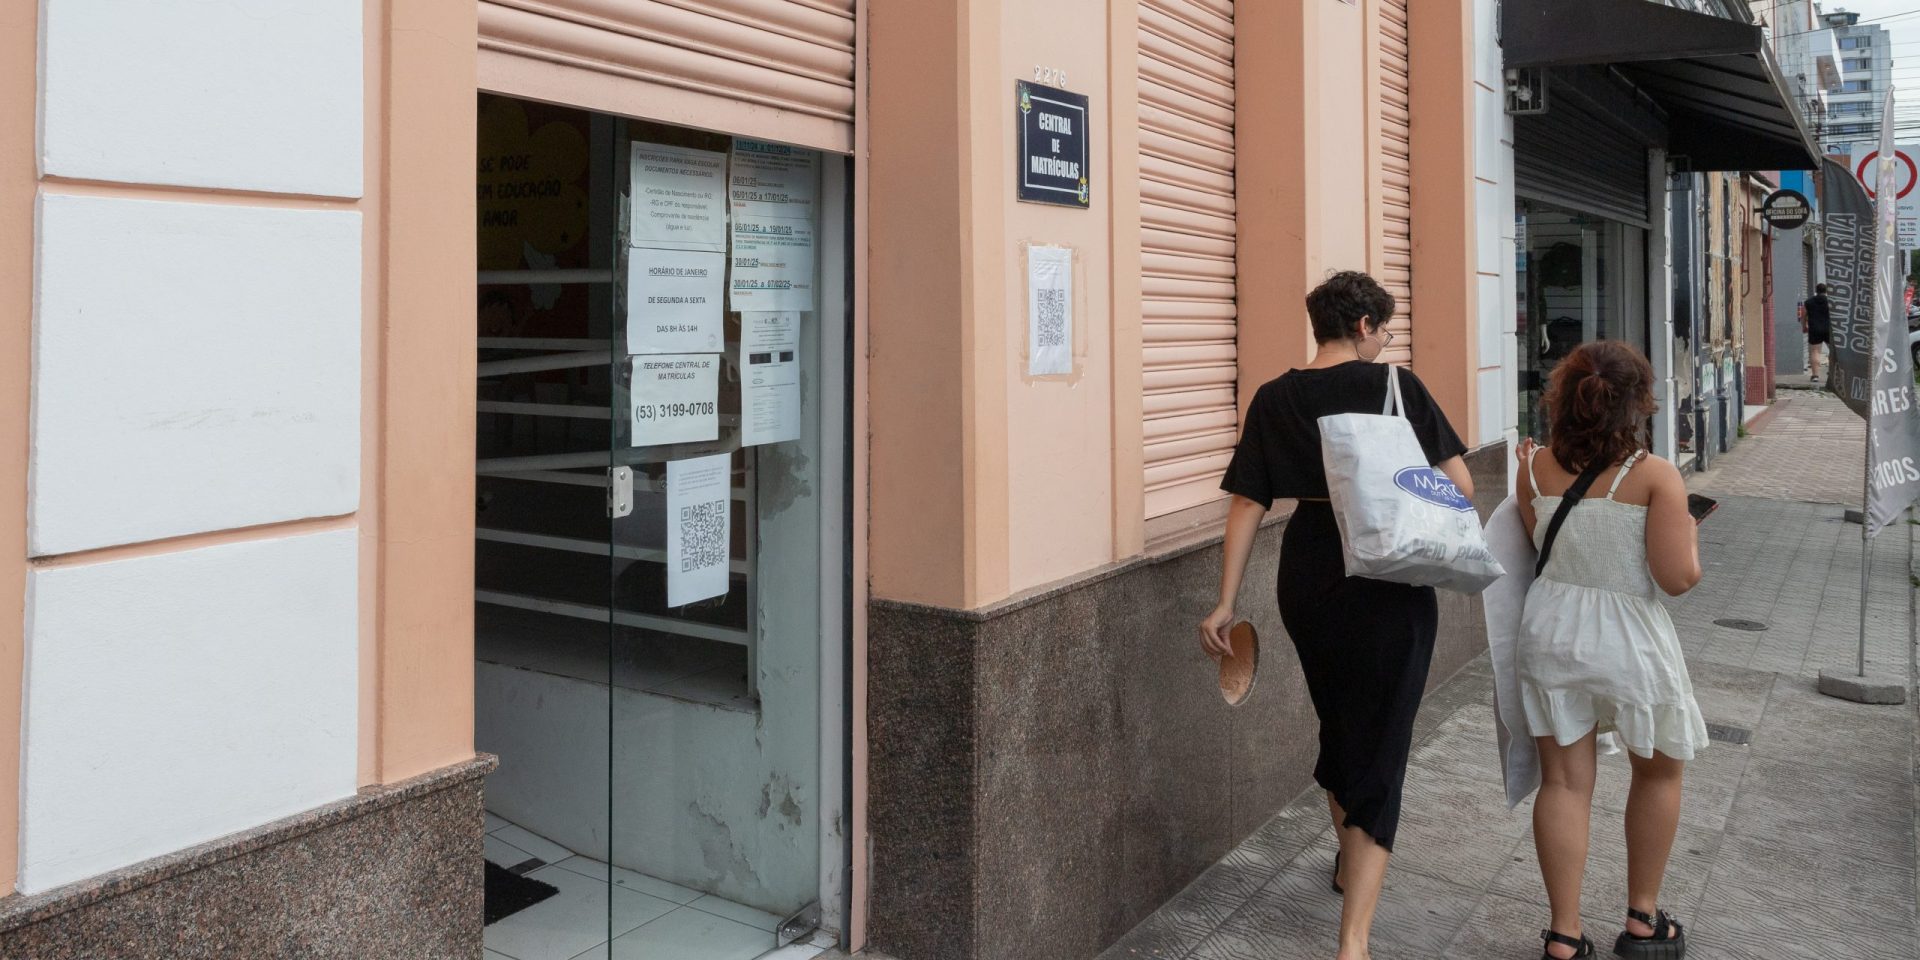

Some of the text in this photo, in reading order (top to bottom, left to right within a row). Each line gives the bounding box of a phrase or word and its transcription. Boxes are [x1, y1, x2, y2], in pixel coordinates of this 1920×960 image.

[1038, 112, 1072, 136] CENTRAL
[1051, 138, 1060, 153] DE
[500, 154, 531, 172] PODE
[1031, 155, 1079, 180] MATRÍCULAS
[764, 192, 789, 203] 17/01/25
[483, 209, 518, 227] AMOR
[648, 266, 708, 277] HORÁRIO DE JANEIRO
[675, 361, 700, 369] CENTRAL
[1872, 385, 1911, 417] ARES
[636, 402, 714, 422] (53) 3199-0708
